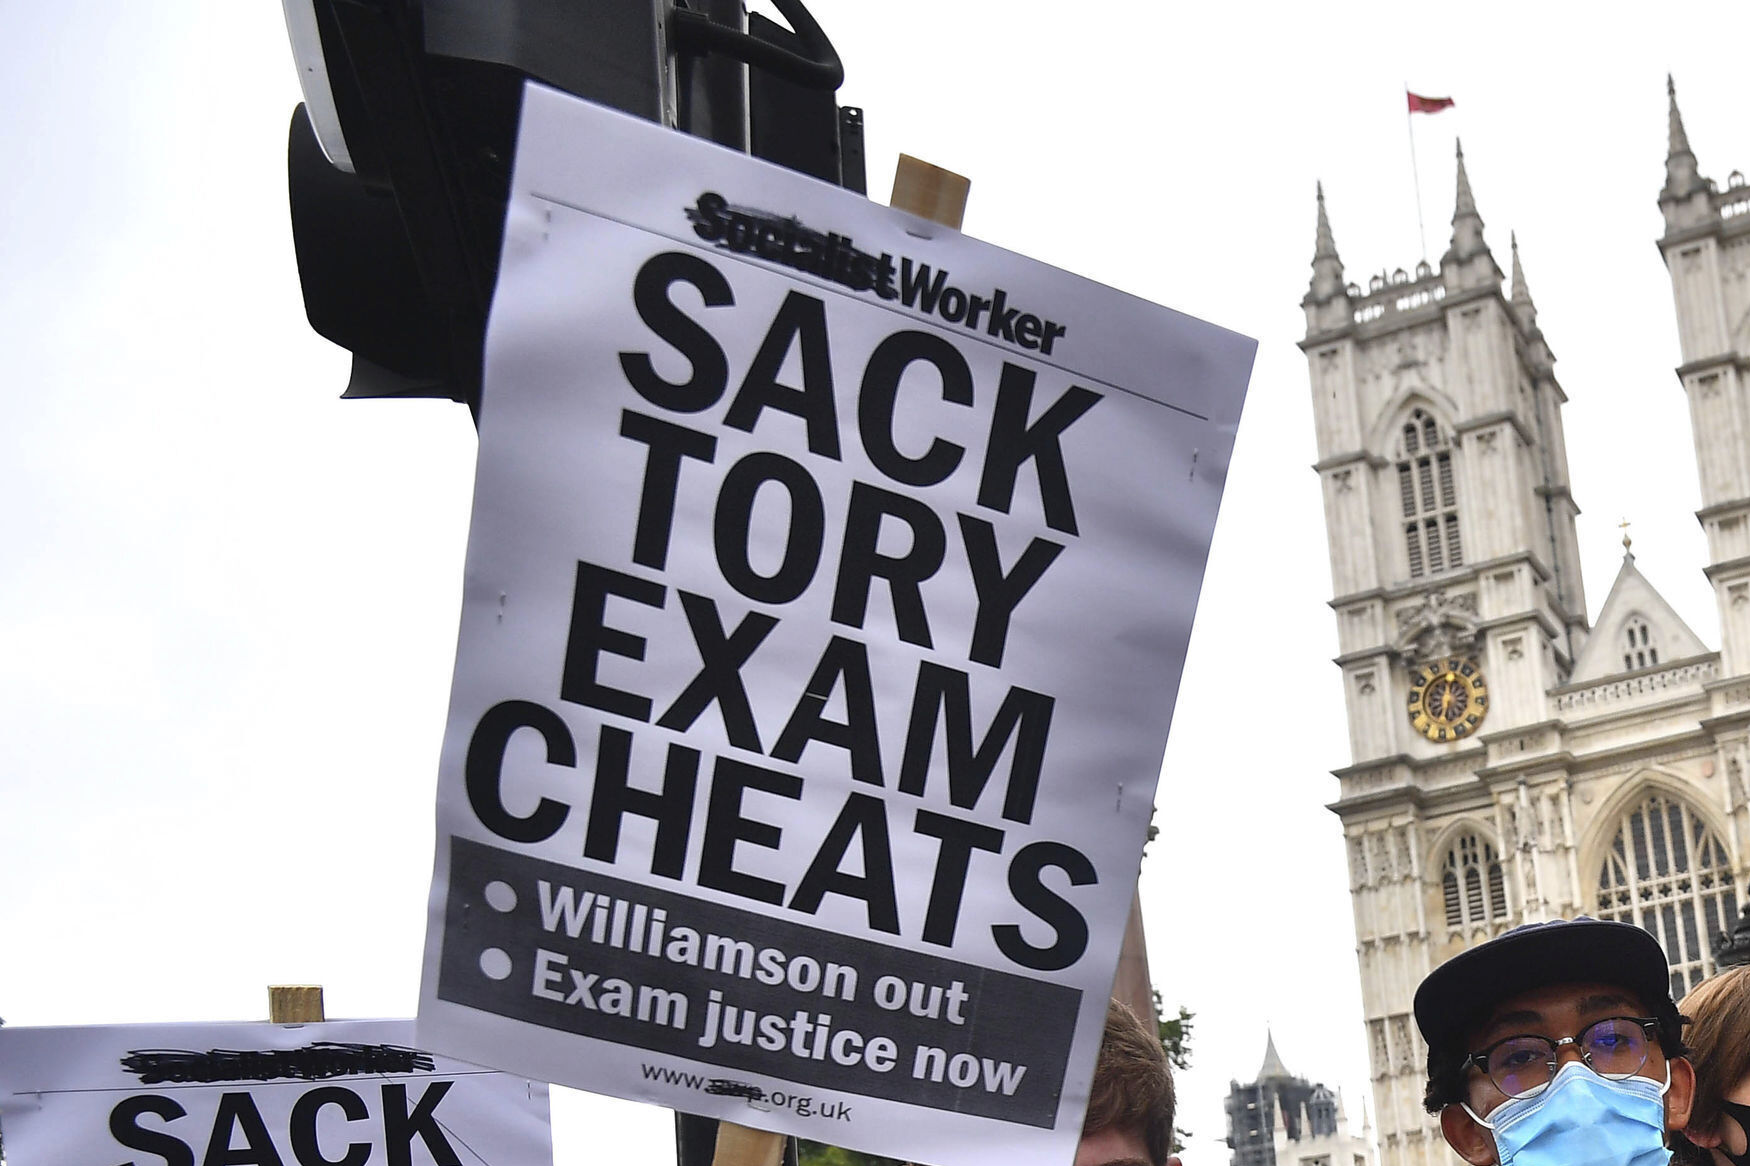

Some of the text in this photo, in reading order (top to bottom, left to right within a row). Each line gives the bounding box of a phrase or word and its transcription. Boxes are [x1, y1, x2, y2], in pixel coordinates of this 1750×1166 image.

[618, 250, 1105, 537] SACK
[619, 408, 1066, 670] TORY
[560, 559, 1056, 826] EXAM
[464, 699, 1099, 972] CHEATS
[536, 880, 969, 1026] Williamson out
[531, 948, 1027, 1096] Exam justice now
